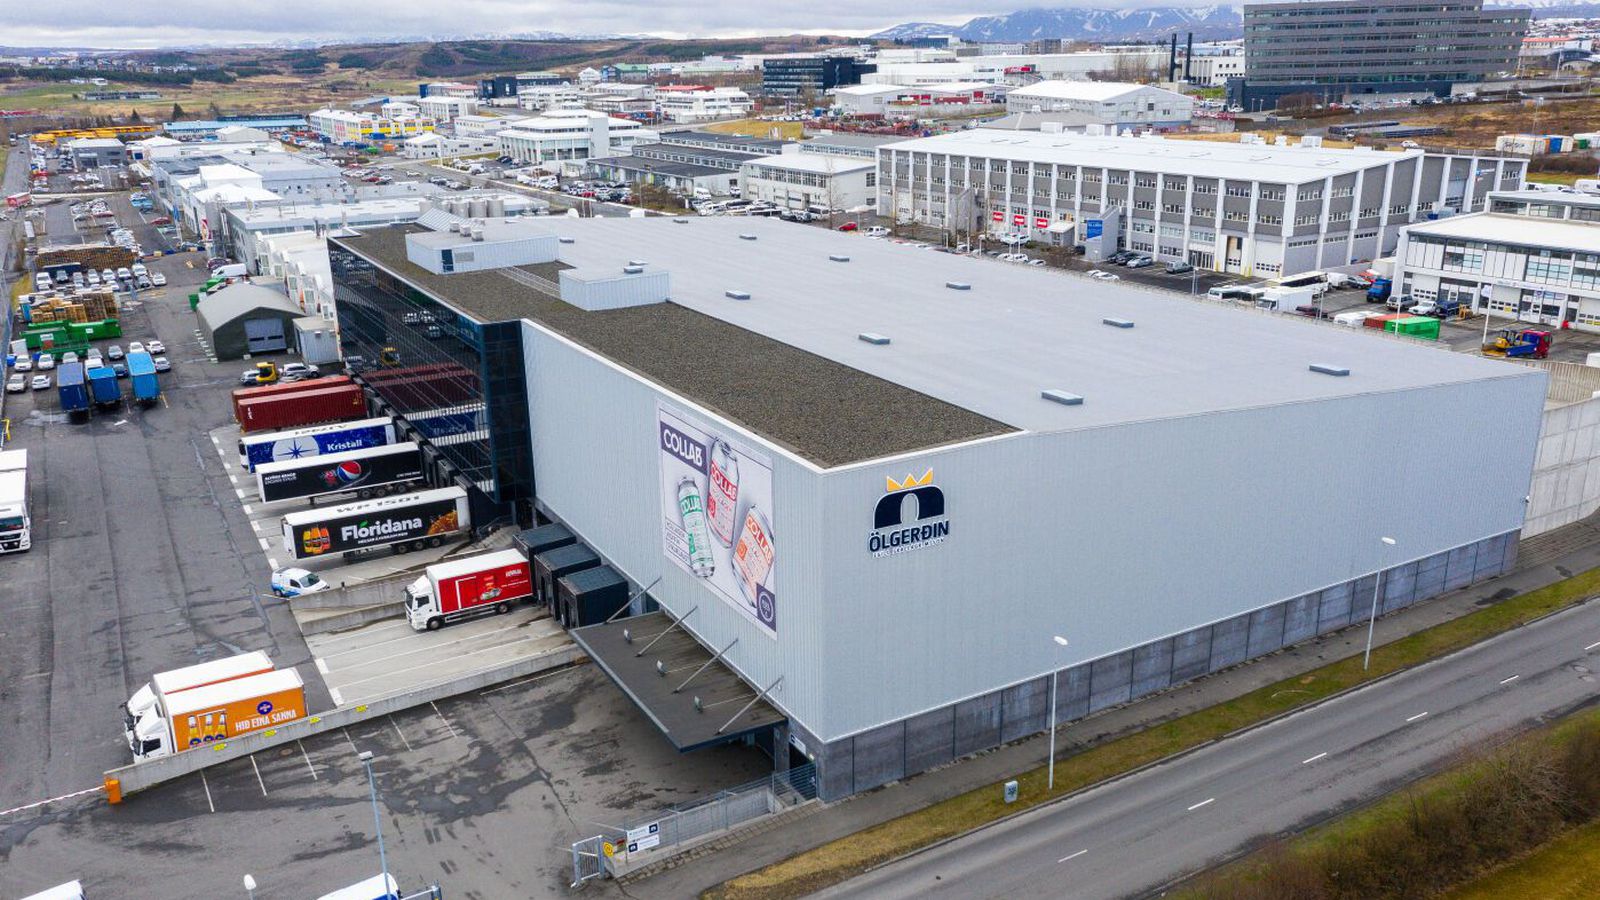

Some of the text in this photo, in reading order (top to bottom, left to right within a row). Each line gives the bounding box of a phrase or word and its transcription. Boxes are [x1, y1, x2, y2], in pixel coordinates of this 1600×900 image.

[327, 439, 363, 451] Kristall
[663, 428, 702, 467] COLLAB
[341, 517, 423, 542] Floridana
[868, 520, 950, 553] ÖLGERÐIN
[272, 709, 296, 722] SANNA
